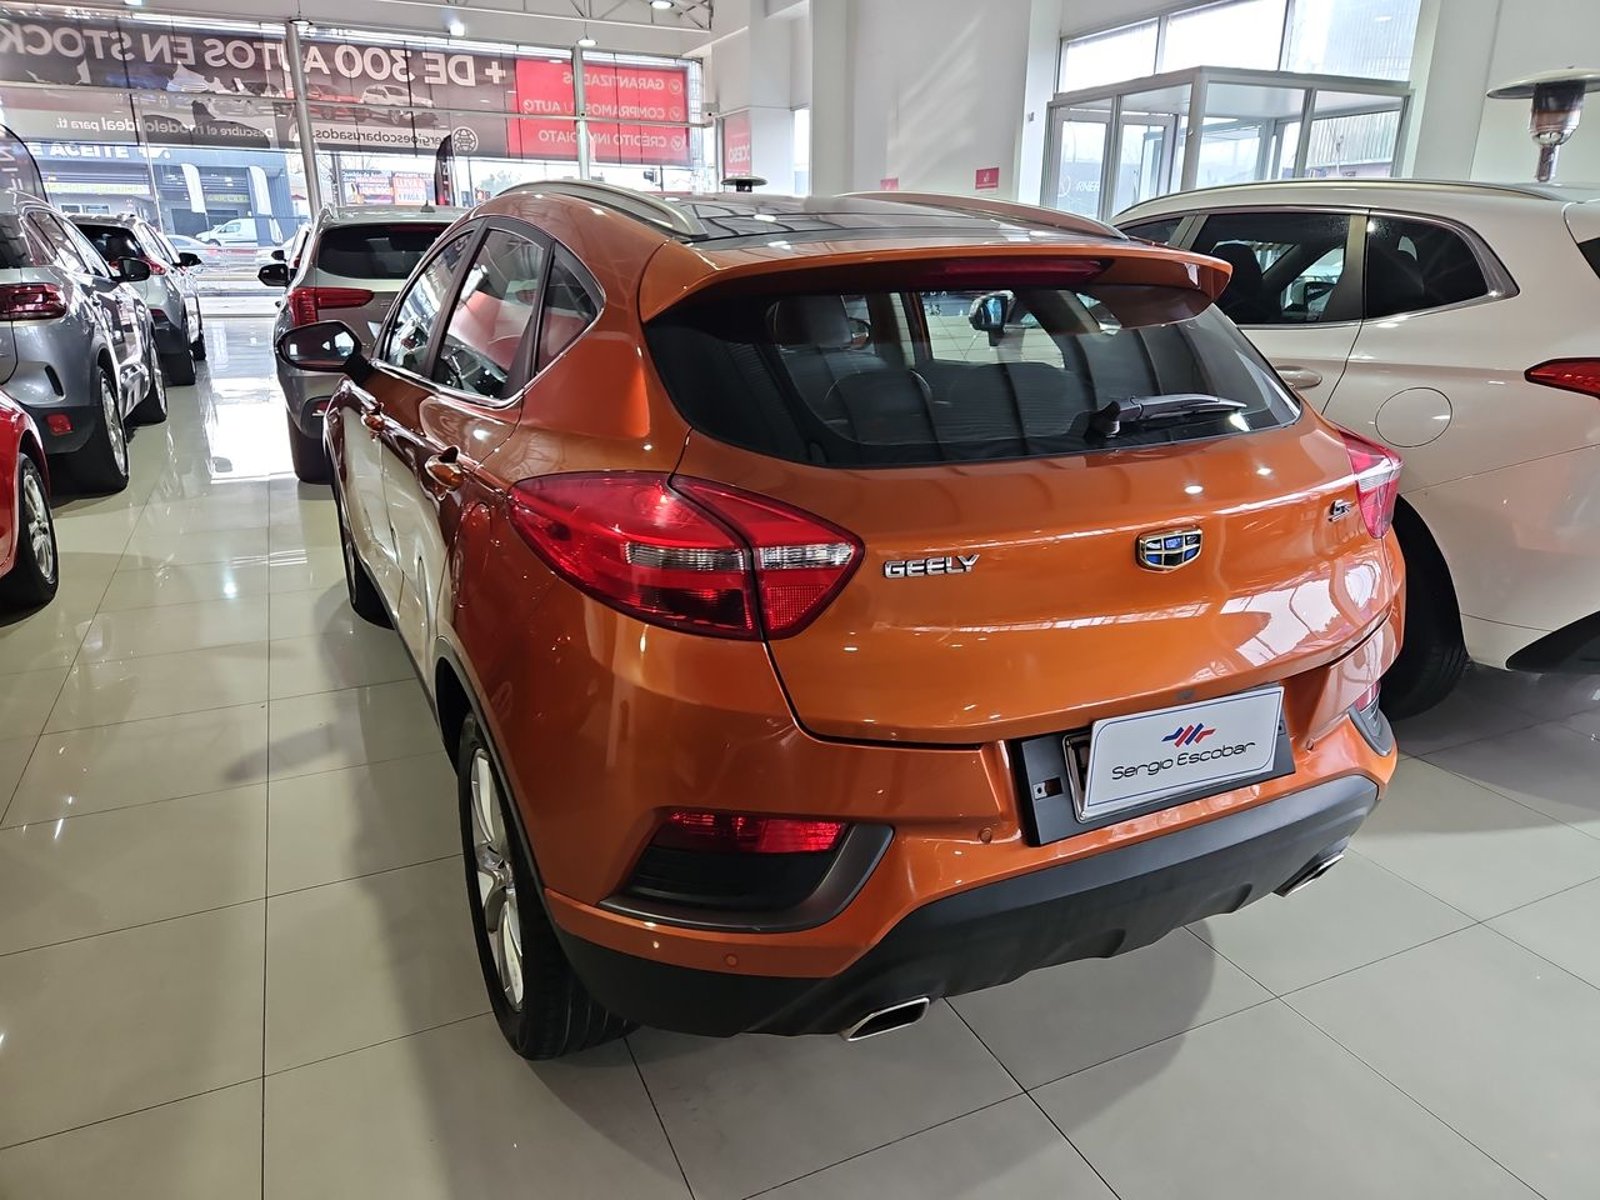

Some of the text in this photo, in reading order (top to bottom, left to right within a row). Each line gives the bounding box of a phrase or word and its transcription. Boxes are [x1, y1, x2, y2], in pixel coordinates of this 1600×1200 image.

[49, 144, 130, 159] ACEITE
[884, 554, 980, 579] GEELY
[1111, 741, 1257, 780] Sergio Escobar
